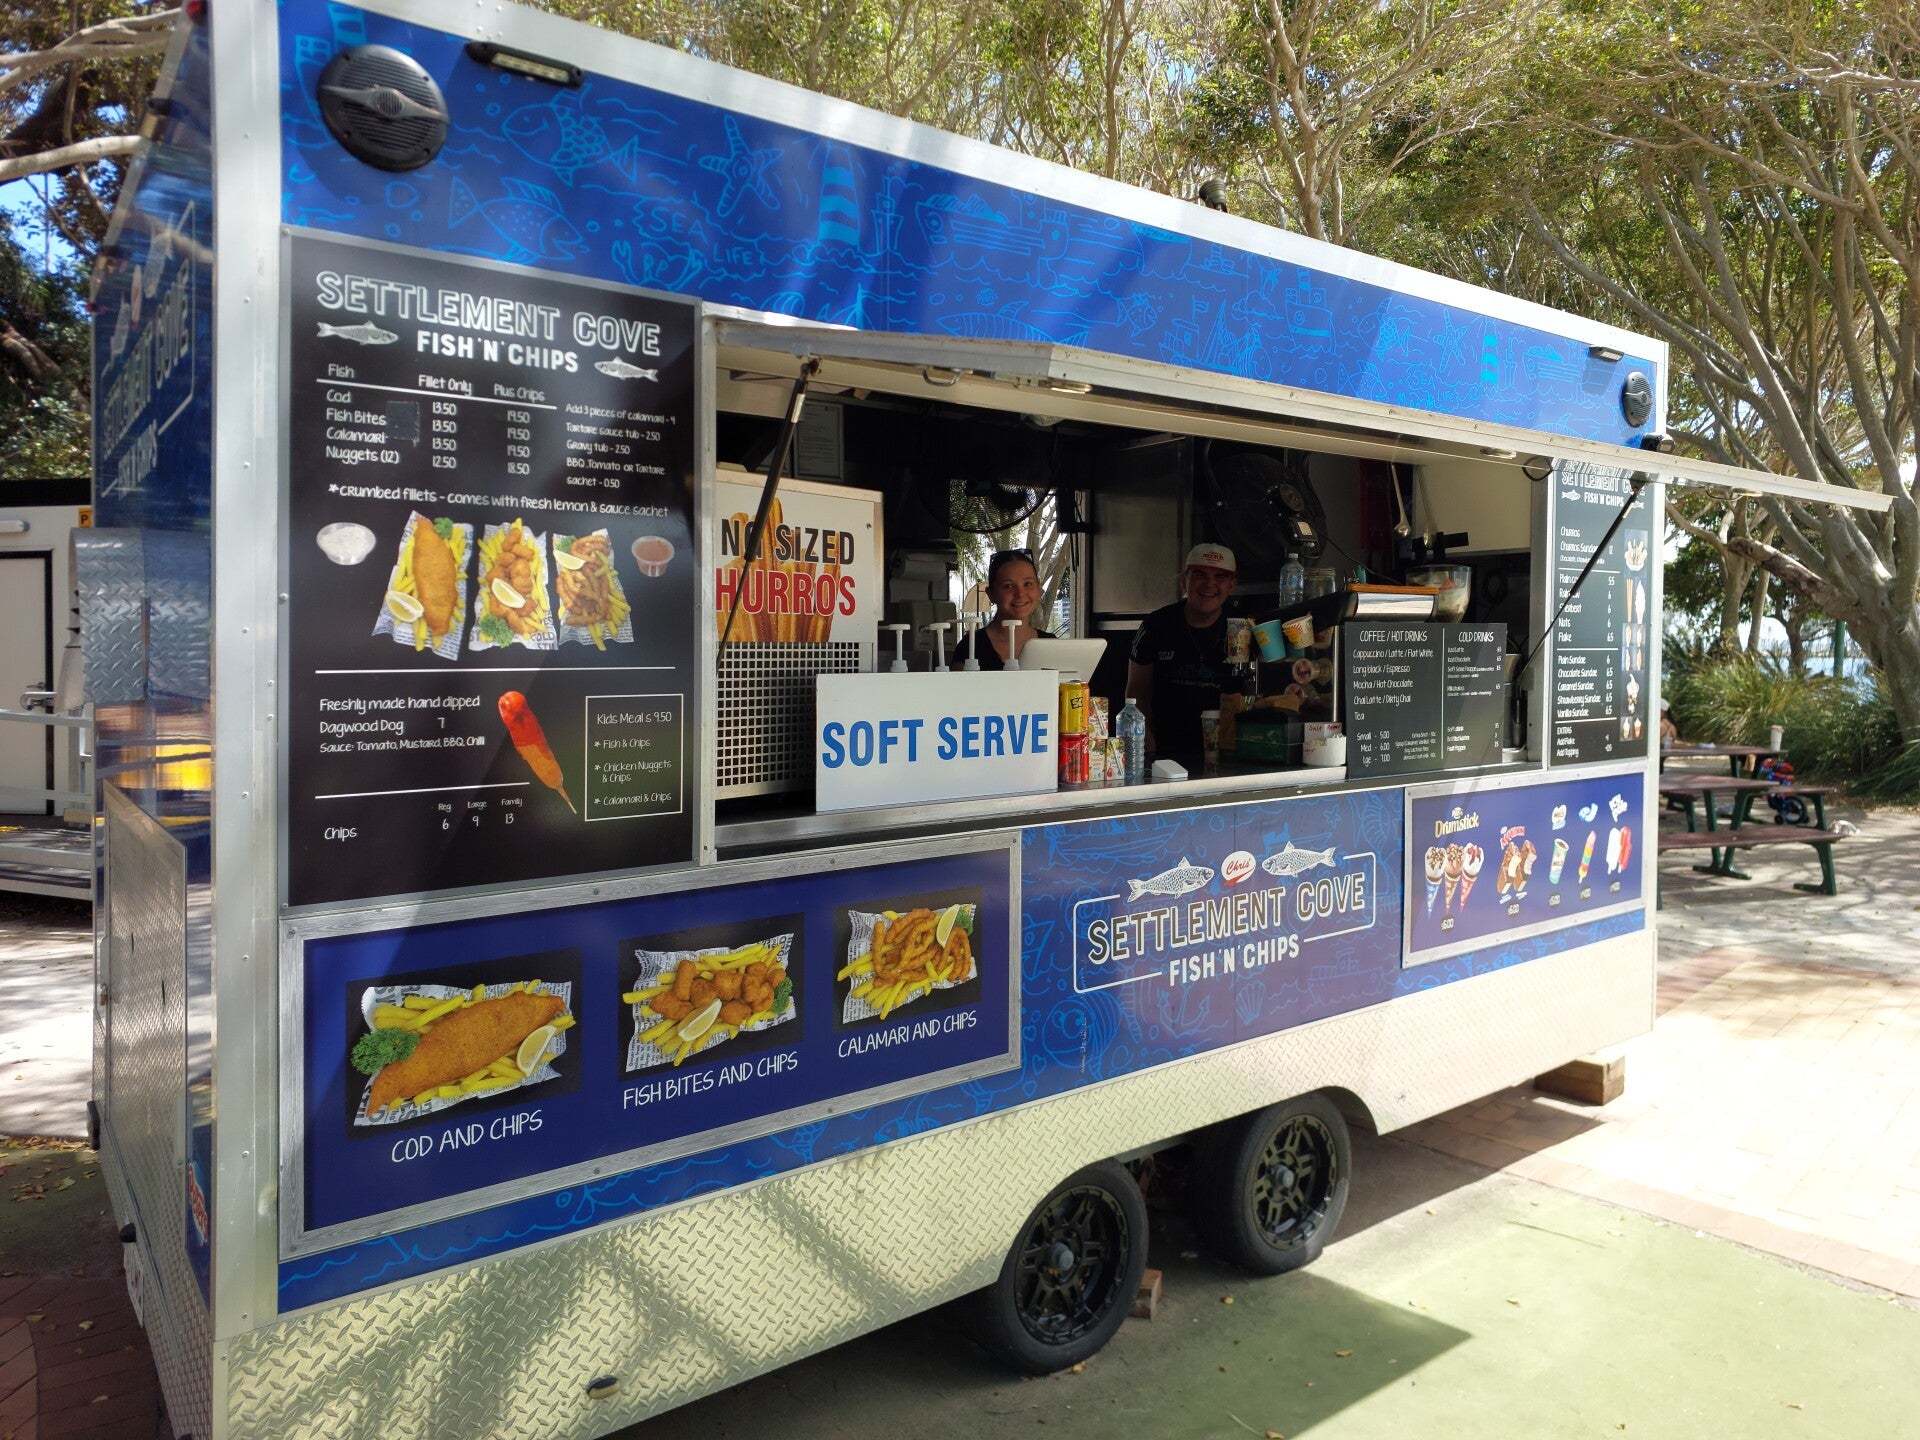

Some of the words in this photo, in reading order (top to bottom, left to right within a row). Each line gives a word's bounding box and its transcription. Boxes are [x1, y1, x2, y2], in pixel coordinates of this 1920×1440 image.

[650, 206, 709, 245] SEA
[713, 242, 753, 265] LIFE
[316, 270, 560, 342] SETTLEMENT
[573, 311, 661, 357] COVE
[416, 329, 475, 360] FISH
[507, 343, 579, 373] CHIPS
[327, 363, 355, 379] Fish
[418, 373, 446, 389] Fillet
[447, 378, 472, 397] Only
[493, 383, 516, 399] Plus
[516, 386, 546, 403] Chips
[326, 388, 351, 403] Cod
[326, 407, 352, 422] Fish
[354, 410, 388, 426] Bites
[565, 403, 583, 415] Add
[589, 406, 616, 419] pieces
[616, 408, 627, 419] of
[627, 411, 665, 424] calamari
[326, 426, 386, 445] Calamari
[565, 422, 598, 435] Tartare
[599, 427, 624, 438] sauce
[625, 428, 639, 440] tub
[326, 445, 379, 465] Nuggets
[380, 450, 400, 464] (12)
[566, 440, 593, 455] Gravy
[594, 442, 609, 453] tub
[635, 463, 666, 476] Tartare
[566, 475, 597, 487] sachet
[402, 487, 437, 502] fillets
[447, 493, 490, 506] comes
[490, 495, 519, 508] with
[520, 496, 551, 511] fresh
[553, 499, 589, 513] lemon
[590, 501, 598, 512] &
[599, 504, 631, 515] sauce
[633, 505, 669, 518] sachet
[1583, 491, 1599, 504] FISH
[1605, 494, 1625, 508] CHIPS
[775, 523, 855, 566] SIZED
[1558, 617, 1571, 628] Nuts
[1360, 630, 1386, 642] COFFEE
[1391, 631, 1404, 642] HOT
[1404, 630, 1428, 642] DRINKS
[1458, 631, 1473, 643] COLD
[1473, 631, 1494, 643] DRINKS
[1558, 631, 1573, 642] Flake
[1353, 649, 1384, 661] Cappuccino
[1388, 649, 1404, 658] Latte
[1407, 648, 1418, 658] Flat
[1419, 648, 1434, 658] White
[1557, 655, 1569, 665] Plain
[1569, 655, 1587, 665] Sundae
[1352, 665, 1366, 678] Long
[1367, 665, 1382, 674] black
[1386, 664, 1411, 675] Espresso
[1557, 668, 1580, 678] Chocolate
[1580, 668, 1598, 677] Sundae
[1353, 680, 1373, 690] Mocha
[1376, 680, 1386, 688] Hot
[1387, 679, 1414, 688] Chocolate
[1577, 681, 1595, 691] Sundae
[319, 698, 367, 715] Freshly
[368, 697, 406, 710] made
[407, 696, 441, 709] hand
[442, 695, 480, 711] dipped
[1353, 695, 1366, 705] Chai
[1366, 695, 1382, 704] Latte
[1386, 694, 1399, 707] Dirty
[1400, 694, 1411, 703] Chai
[1584, 694, 1602, 703] Sundae
[597, 713, 618, 724] Kids
[1354, 711, 1365, 720] Tea
[1571, 707, 1590, 717] Sundae
[319, 720, 379, 738] Dagwood
[380, 719, 404, 736] Dog
[437, 717, 445, 729] 7
[603, 739, 621, 749] Fish
[622, 739, 627, 748] &
[629, 738, 651, 748] Chips
[822, 718, 924, 769] SOFT
[938, 713, 1049, 762] SERVE
[1356, 732, 1372, 741] Small
[1360, 743, 1372, 752] Med
[603, 762, 637, 772] Chicken
[638, 759, 672, 774] Nuggets
[602, 774, 608, 783] &
[609, 773, 632, 785] Chips
[438, 802, 452, 812] Reg
[467, 800, 487, 810] Large
[501, 797, 523, 807] Family
[603, 795, 643, 806] Calamari
[650, 792, 672, 804] Chips
[324, 826, 358, 842] Chips
[442, 818, 449, 830] 6
[472, 816, 480, 827] 9
[505, 812, 514, 824] 13
[1435, 811, 1480, 839] Drumstick
[1087, 887, 1286, 965] SETTLEMENT
[1296, 872, 1365, 921] COVE
[1169, 951, 1215, 987] FISH
[1243, 933, 1299, 969] CHIPS
[838, 1026, 910, 1059] CALAMARI
[911, 1019, 942, 1041] AND
[943, 1009, 978, 1034] CHIPS
[622, 1078, 662, 1110] FISH
[664, 1068, 713, 1101] BITES
[717, 1062, 753, 1088] AND
[756, 1050, 799, 1080] CHIPS
[391, 1134, 433, 1163] COD
[438, 1123, 485, 1153] AND
[489, 1109, 543, 1140] CHIPS
